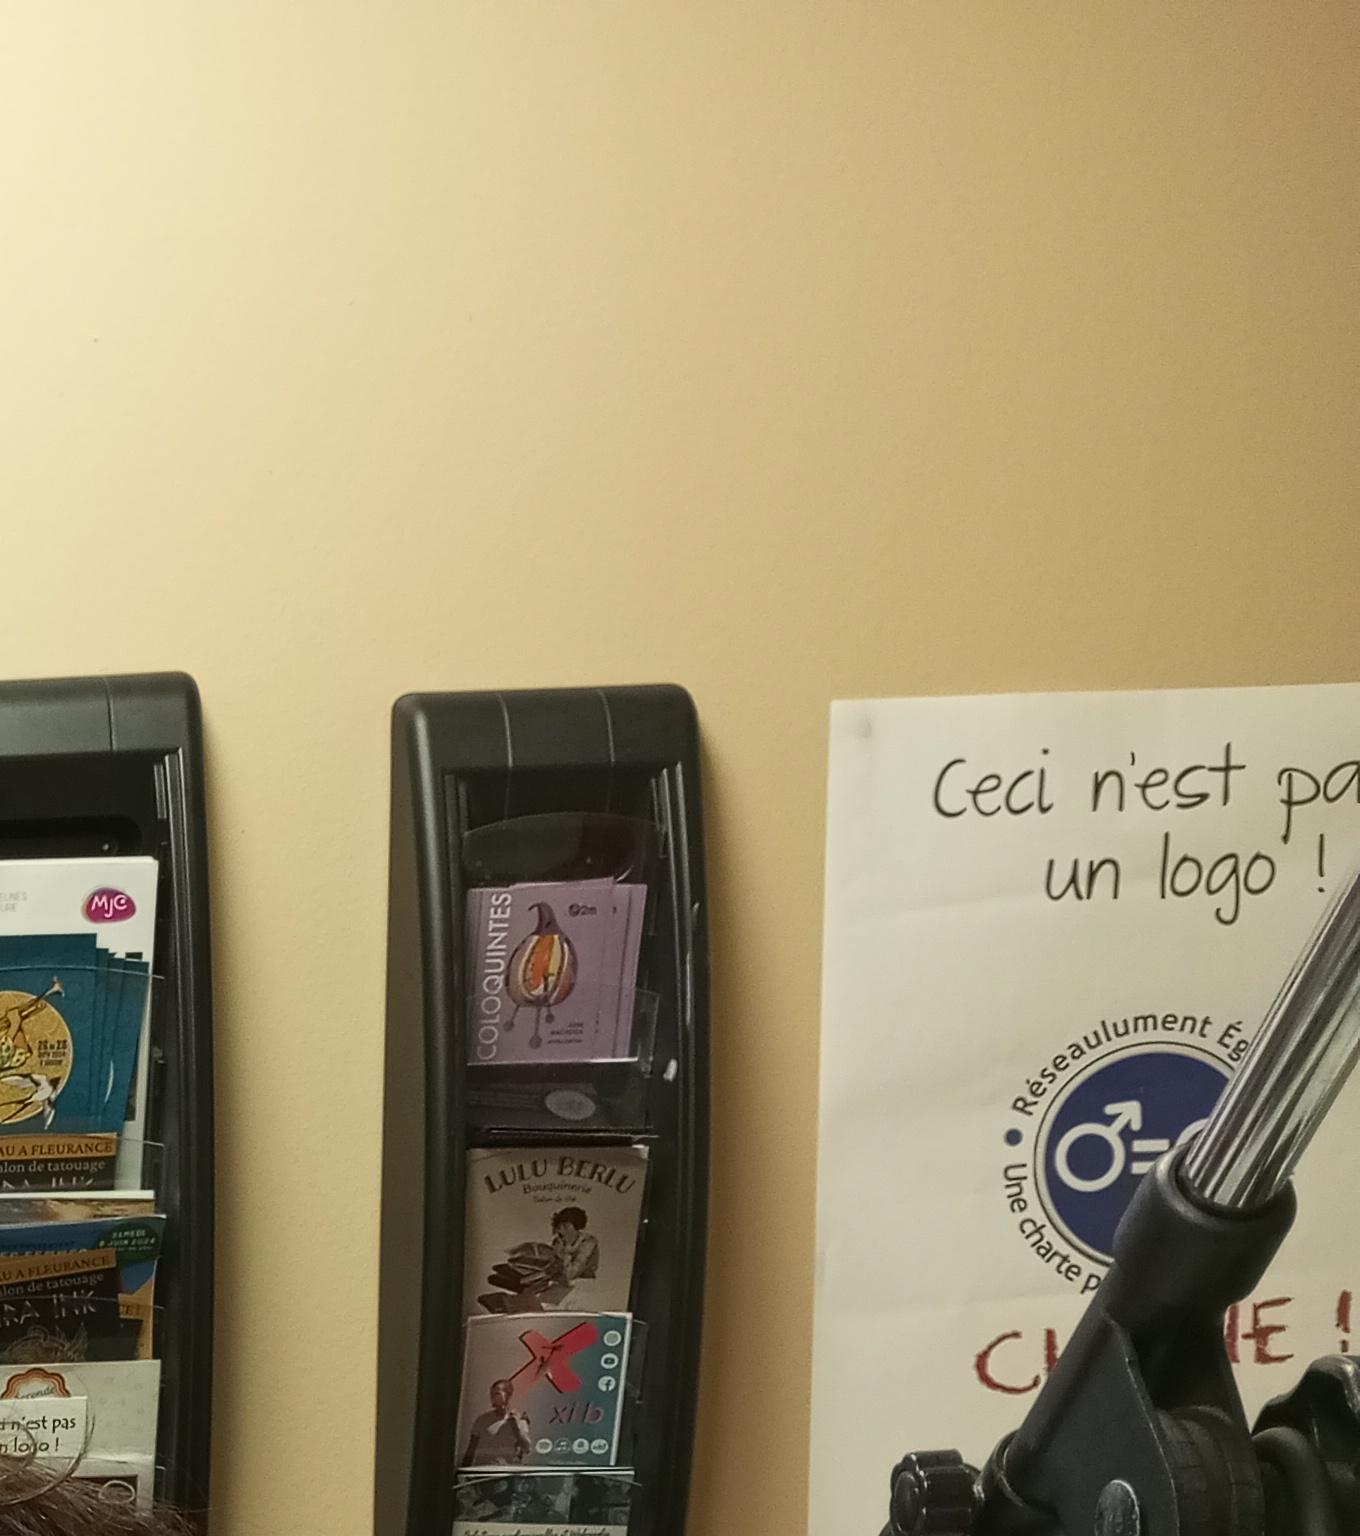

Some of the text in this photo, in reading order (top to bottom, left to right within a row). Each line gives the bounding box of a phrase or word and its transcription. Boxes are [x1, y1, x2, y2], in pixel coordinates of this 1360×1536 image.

[932, 747, 1055, 819] Ceci
[1091, 741, 1247, 813] n'est
[1044, 856, 1122, 903] un
[1160, 831, 1276, 926] logo
[476, 891, 513, 1061] COLOQUINTES
[1011, 1012, 1251, 1117] Réseaulument Ég
[17, 1143, 29, 1158] A
[30, 1139, 114, 1157] FLEURANCE
[28, 1159, 46, 1173] de
[47, 1158, 106, 1176] tatouage
[483, 1155, 636, 1195] LULU BERLU
[522, 1180, 593, 1195] Bouquinerie
[1002, 1162, 1102, 1295] Une charte p
[27, 1278, 43, 1293] de
[44, 1270, 105, 1291] tatouage
[28, 1255, 110, 1279] FLEURANCE
[11, 1415, 48, 1432] n'est
[52, 1416, 77, 1433] pas
